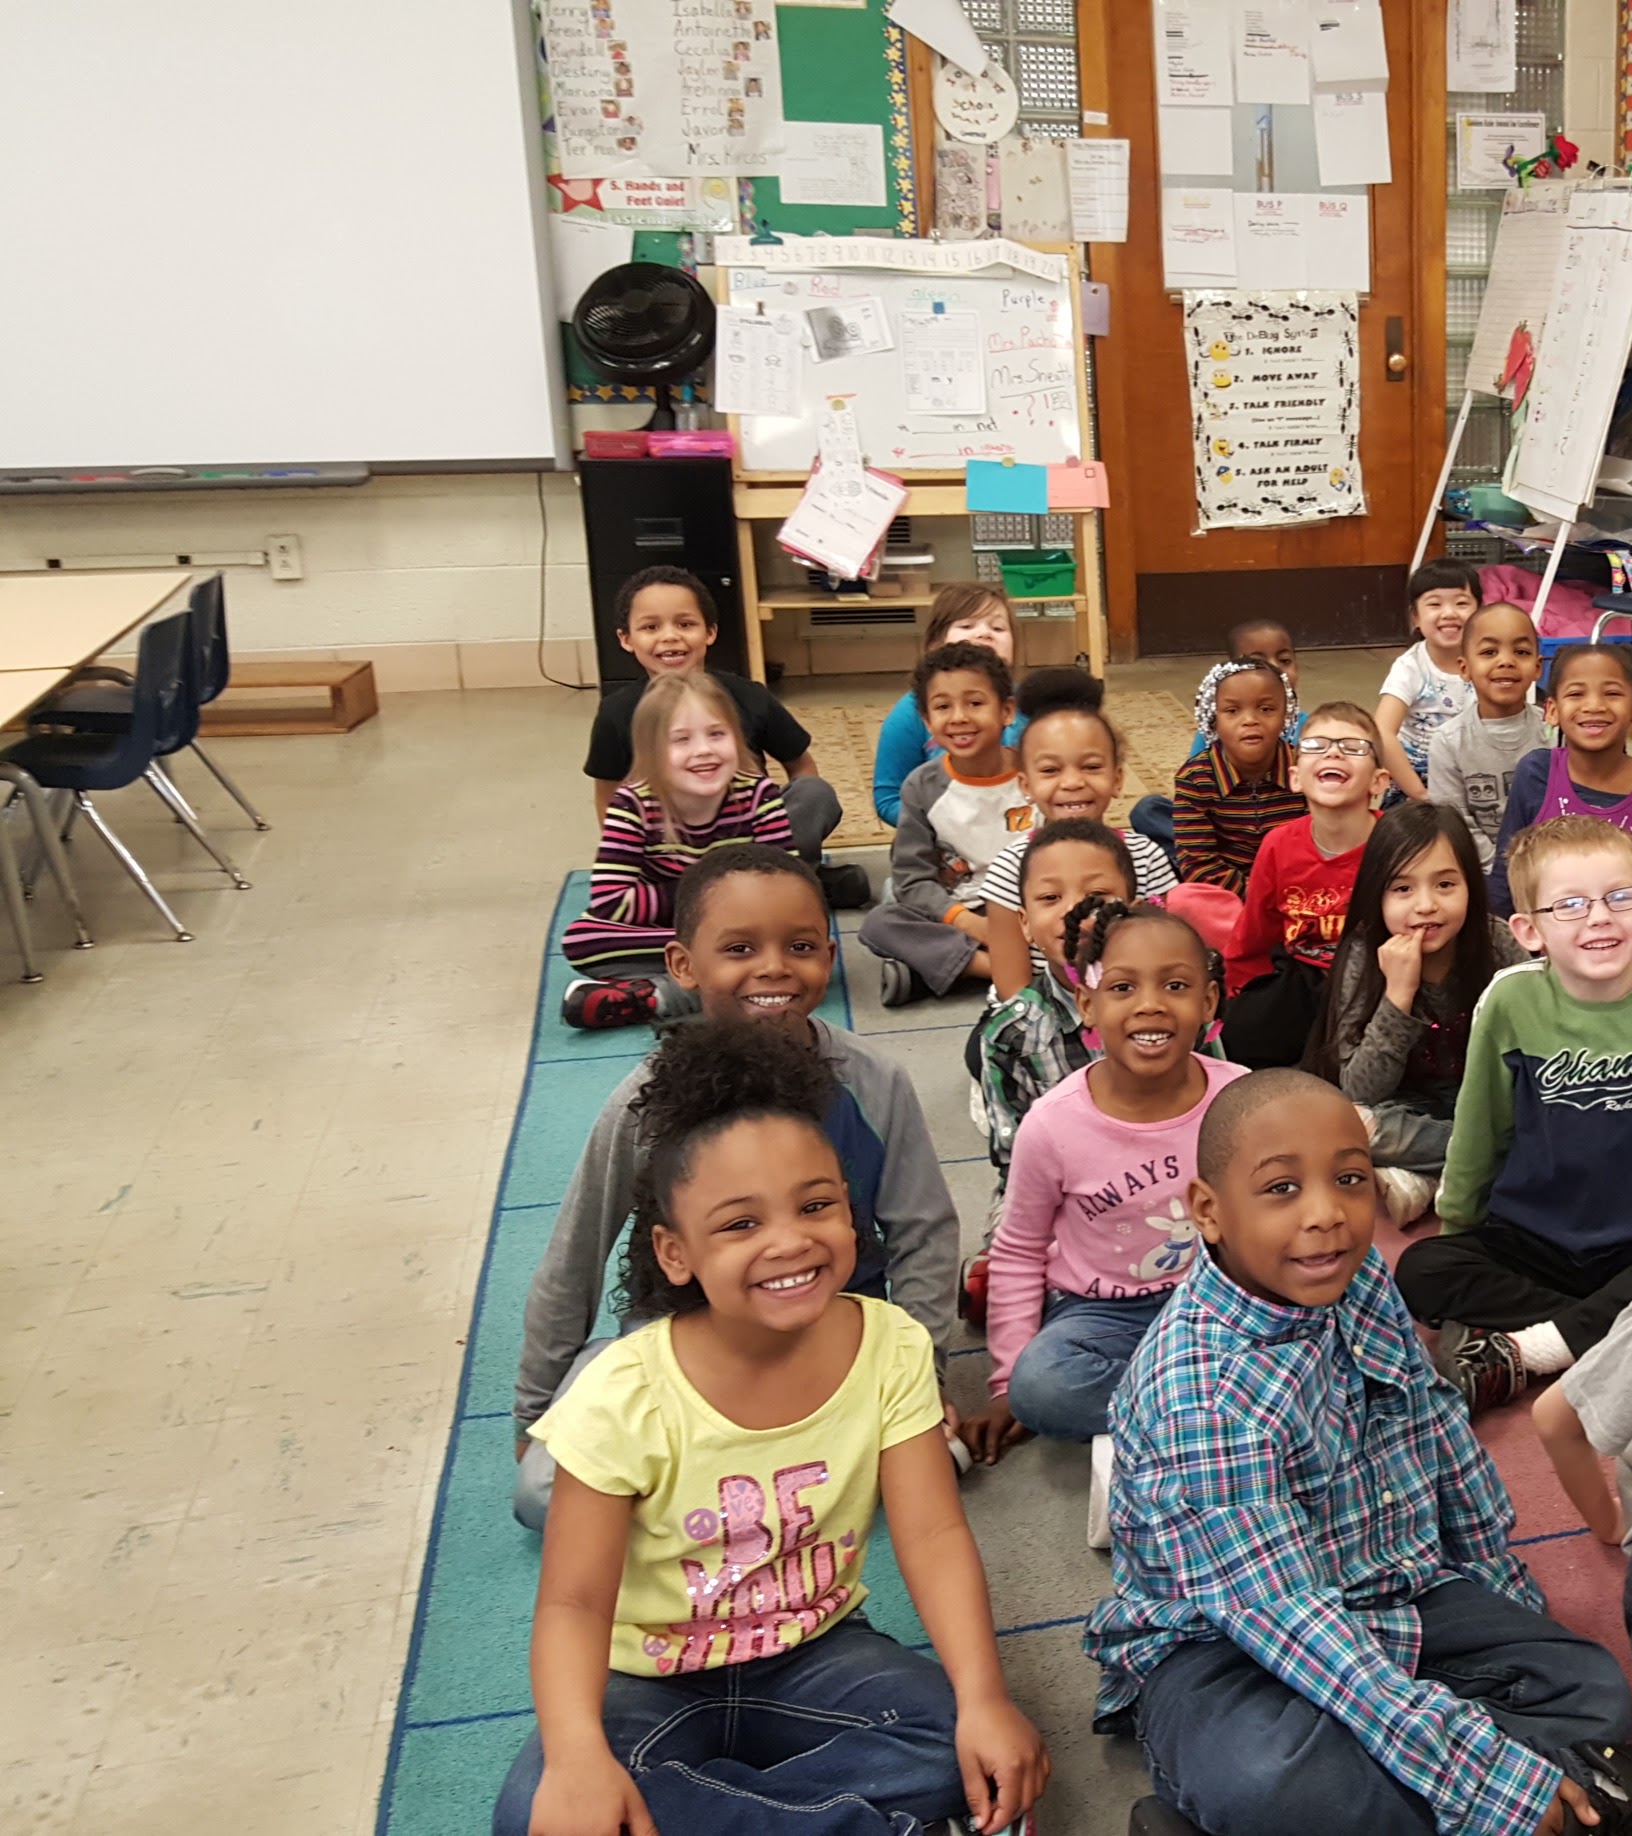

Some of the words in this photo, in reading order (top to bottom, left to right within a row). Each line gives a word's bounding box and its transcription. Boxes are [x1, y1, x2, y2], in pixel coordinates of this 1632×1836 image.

[625, 180, 662, 192] Hands
[666, 180, 685, 192] and
[626, 195, 652, 206] Feet
[1256, 200, 1275, 209] BUS
[1319, 201, 1337, 210] BUS
[811, 274, 840, 295] Red
[1001, 287, 1047, 309] Purple
[1245, 347, 1254, 356] 1.
[1262, 345, 1303, 355] IGNORE
[1233, 375, 1244, 383] 2.
[1251, 373, 1282, 383] MOVE
[1286, 371, 1319, 381] AWAY
[1243, 400, 1270, 410] TALK
[1273, 398, 1327, 409] FRIENDLY
[1237, 441, 1250, 450] 4.
[1253, 439, 1280, 449] TALK
[1283, 437, 1323, 448] FIRMLY
[1250, 466, 1271, 476] ASK
[1275, 466, 1291, 474] AN
[1295, 463, 1329, 473] ADULT
[1256, 479, 1279, 488] FOR
[1281, 478, 1309, 487] HELP
[1076, 1154, 1180, 1222] ALWAYS
[717, 1459, 831, 1565] BE
